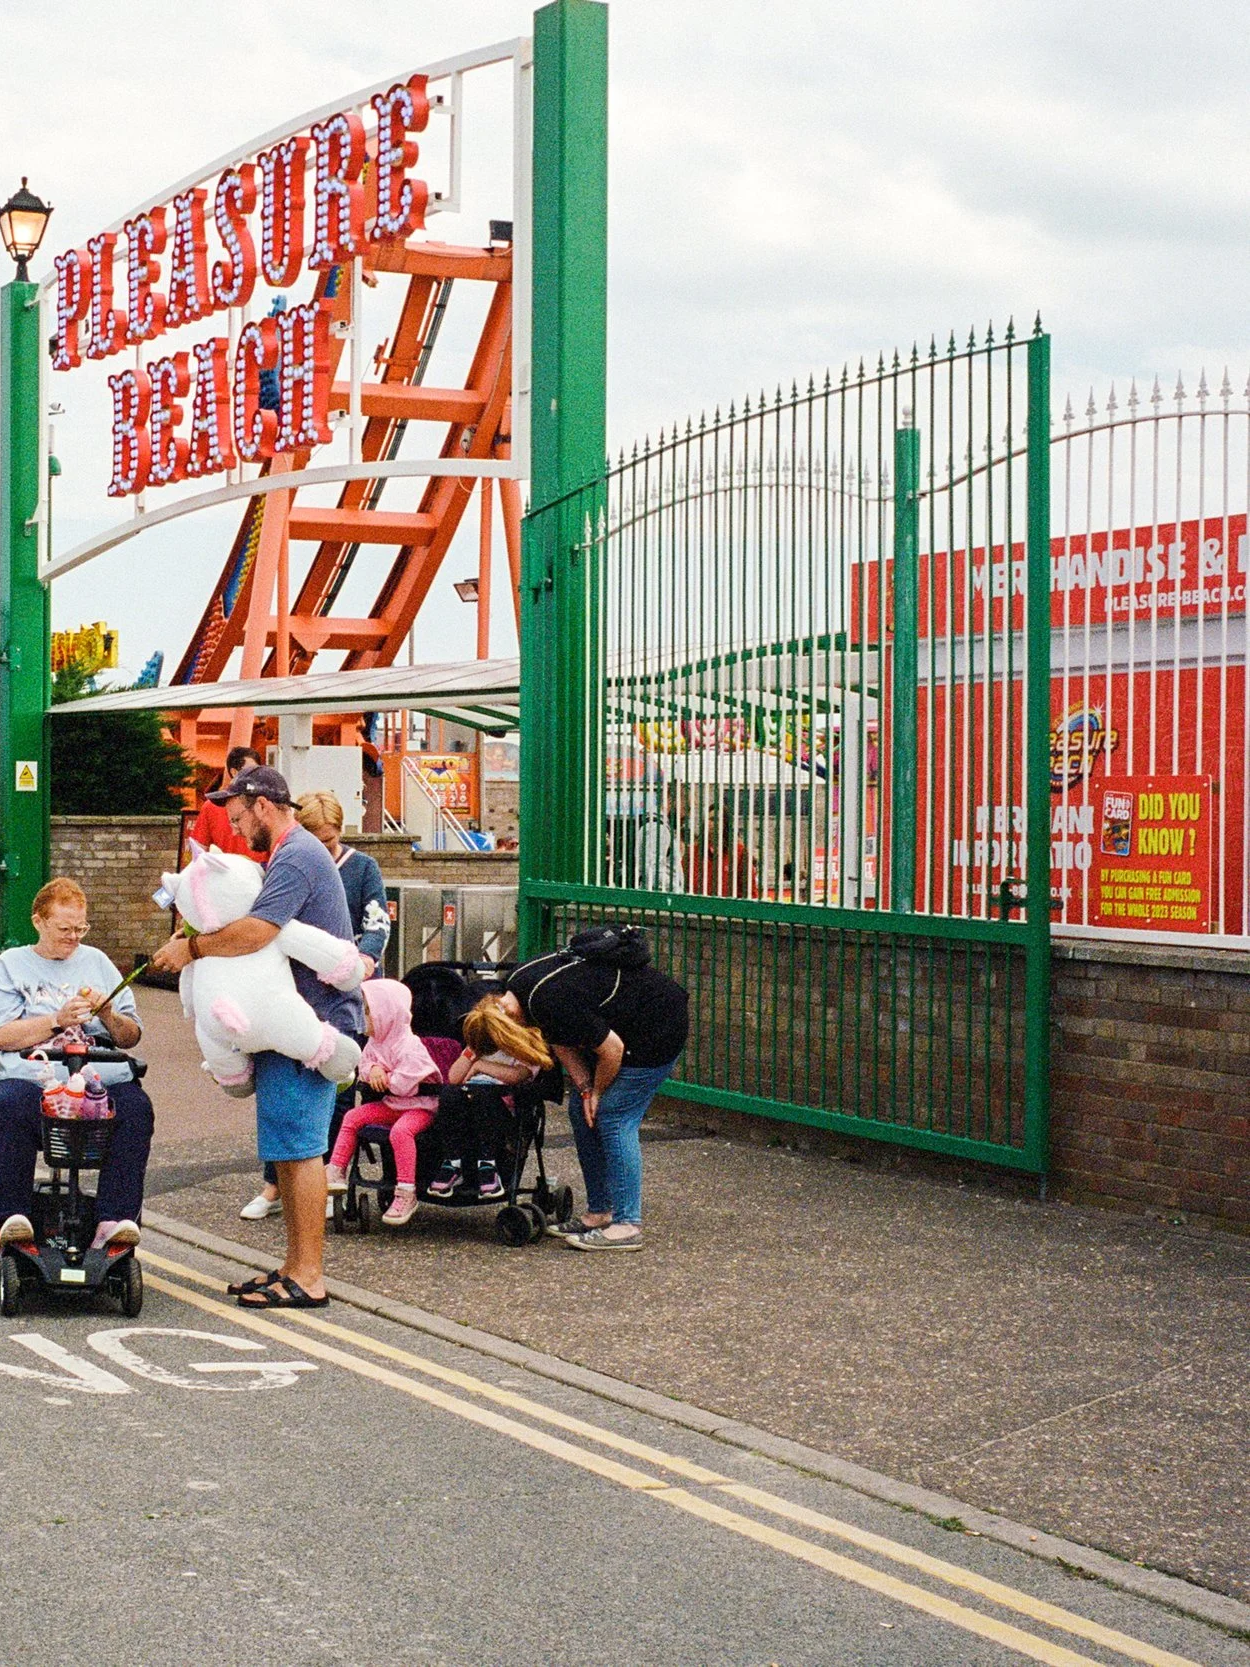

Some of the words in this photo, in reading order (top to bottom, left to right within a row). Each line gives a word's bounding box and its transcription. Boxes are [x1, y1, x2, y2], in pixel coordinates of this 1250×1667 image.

[53, 74, 429, 370] PLEASURE
[108, 298, 332, 497] BEACH
[972, 541, 1186, 600] MERHANDISE
[1105, 797, 1125, 809] FUN
[1138, 793, 1164, 820] DID
[1169, 793, 1200, 820] YOU
[1104, 808, 1130, 821] CARD
[1138, 828, 1184, 855] KNOW
[1189, 828, 1196, 856] ?
[1110, 869, 1151, 884] PURCHASING
[1158, 871, 1172, 885] FUN
[1173, 871, 1192, 886] CARD
[1101, 886, 1113, 899] YOU
[1114, 886, 1127, 900] CAN
[1128, 886, 1144, 901] GAIN
[1145, 887, 1162, 901] FREE
[1163, 888, 1201, 903] ADMISSION
[1101, 902, 1113, 915] FOR
[1114, 903, 1126, 916] THE
[1127, 903, 1150, 917] WHOLE
[1151, 904, 1169, 919] 2023
[1170, 905, 1197, 920] SEASON
